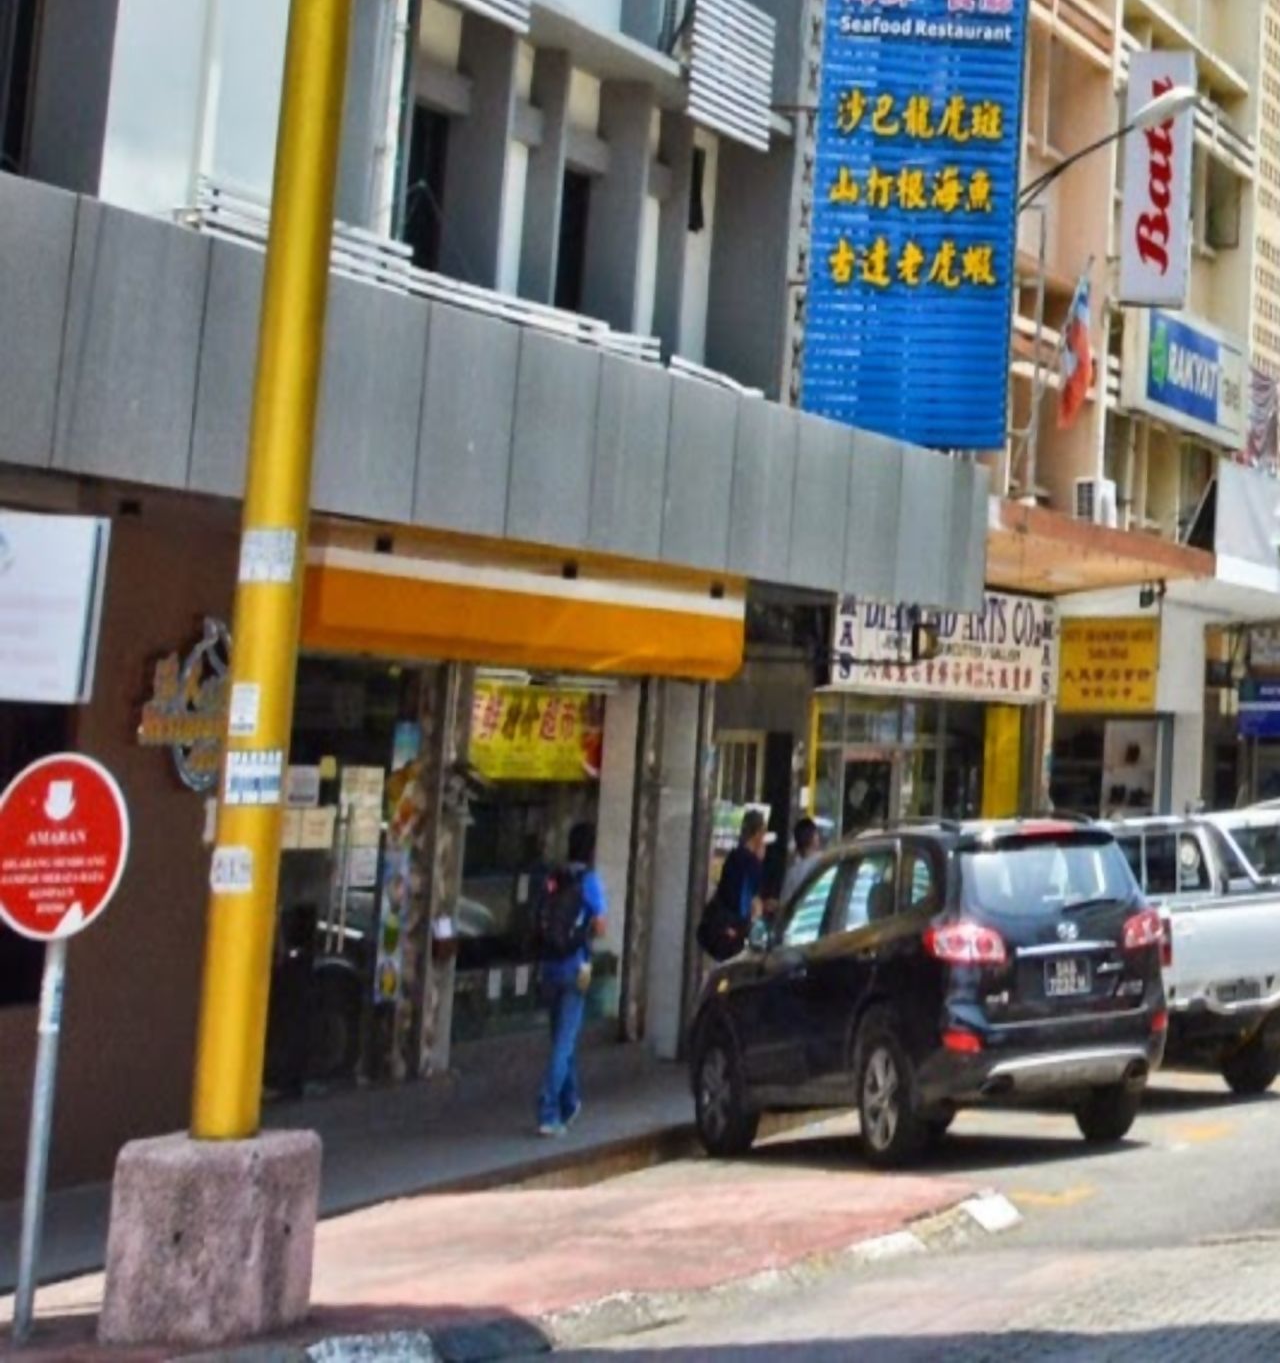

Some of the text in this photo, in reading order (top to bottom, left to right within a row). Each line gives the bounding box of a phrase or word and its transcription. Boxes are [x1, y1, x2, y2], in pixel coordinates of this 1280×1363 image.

[841, 16, 1012, 42] Seafood Restaurant
[27, 830, 87, 846] AMARAN
